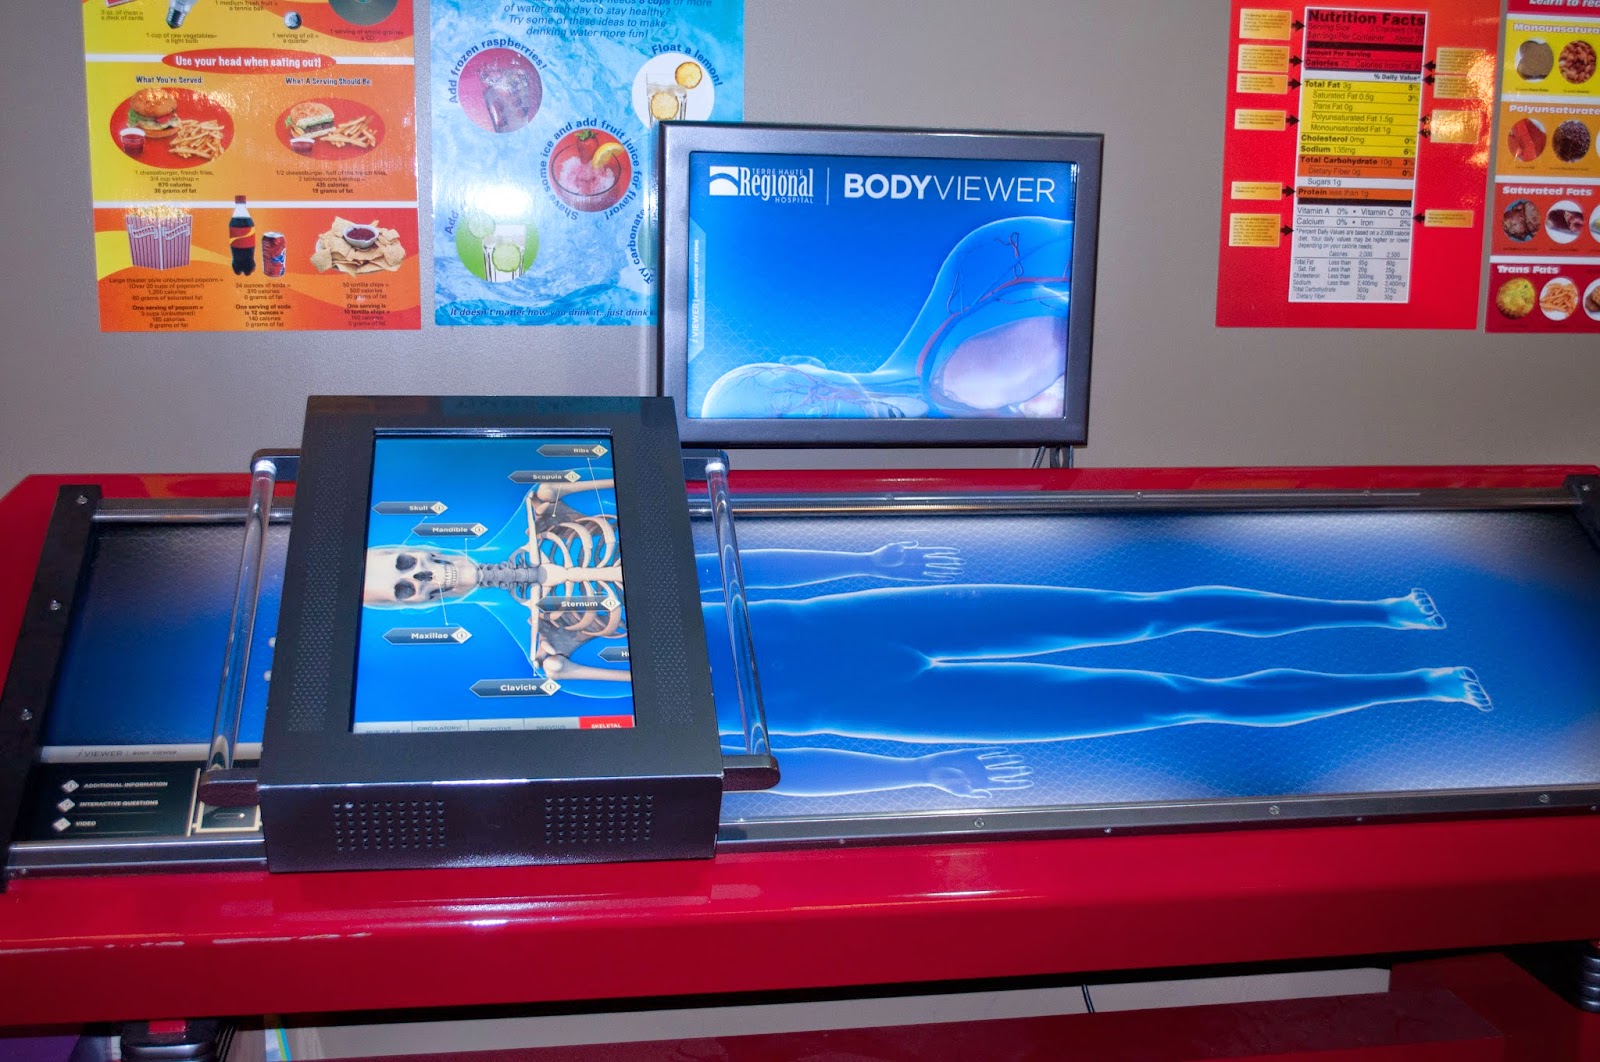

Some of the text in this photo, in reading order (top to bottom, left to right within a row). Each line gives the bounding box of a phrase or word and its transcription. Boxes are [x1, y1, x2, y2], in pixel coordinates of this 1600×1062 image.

[504, 3, 515, 12] of
[547, 5, 570, 13] each
[573, 6, 590, 16] day
[606, 7, 626, 16] stay
[629, 7, 671, 16] healthy?
[509, 14, 523, 25] Try
[556, 16, 567, 24] of
[569, 16, 596, 26] these
[599, 17, 624, 26] ideas
[627, 18, 637, 27] to
[639, 18, 666, 28] make
[1309, 10, 1425, 26] Nutrition Facts
[526, 27, 566, 38] drinking
[570, 29, 598, 37] water
[628, 29, 649, 39] fun!
[175, 56, 321, 69] Use your head when eating out!
[651, 43, 682, 55] Float
[694, 49, 723, 87] lemon!
[448, 37, 547, 104] Add frozen raspberries!
[1312, 91, 1358, 100] Saturated Fat
[1312, 113, 1365, 122] Polyunsaturated
[1311, 124, 1368, 132] Monounsaturated
[1323, 156, 1378, 166] Carbohydrate
[540, 118, 642, 220] Shave some ice and add fruit juice for flavor!
[739, 166, 814, 201] Regional
[1308, 178, 1330, 186] Sugars
[1502, 186, 1592, 196] Saturated Fats
[628, 206, 654, 284] Try carbonate
[1497, 265, 1559, 274] Trans Fats
